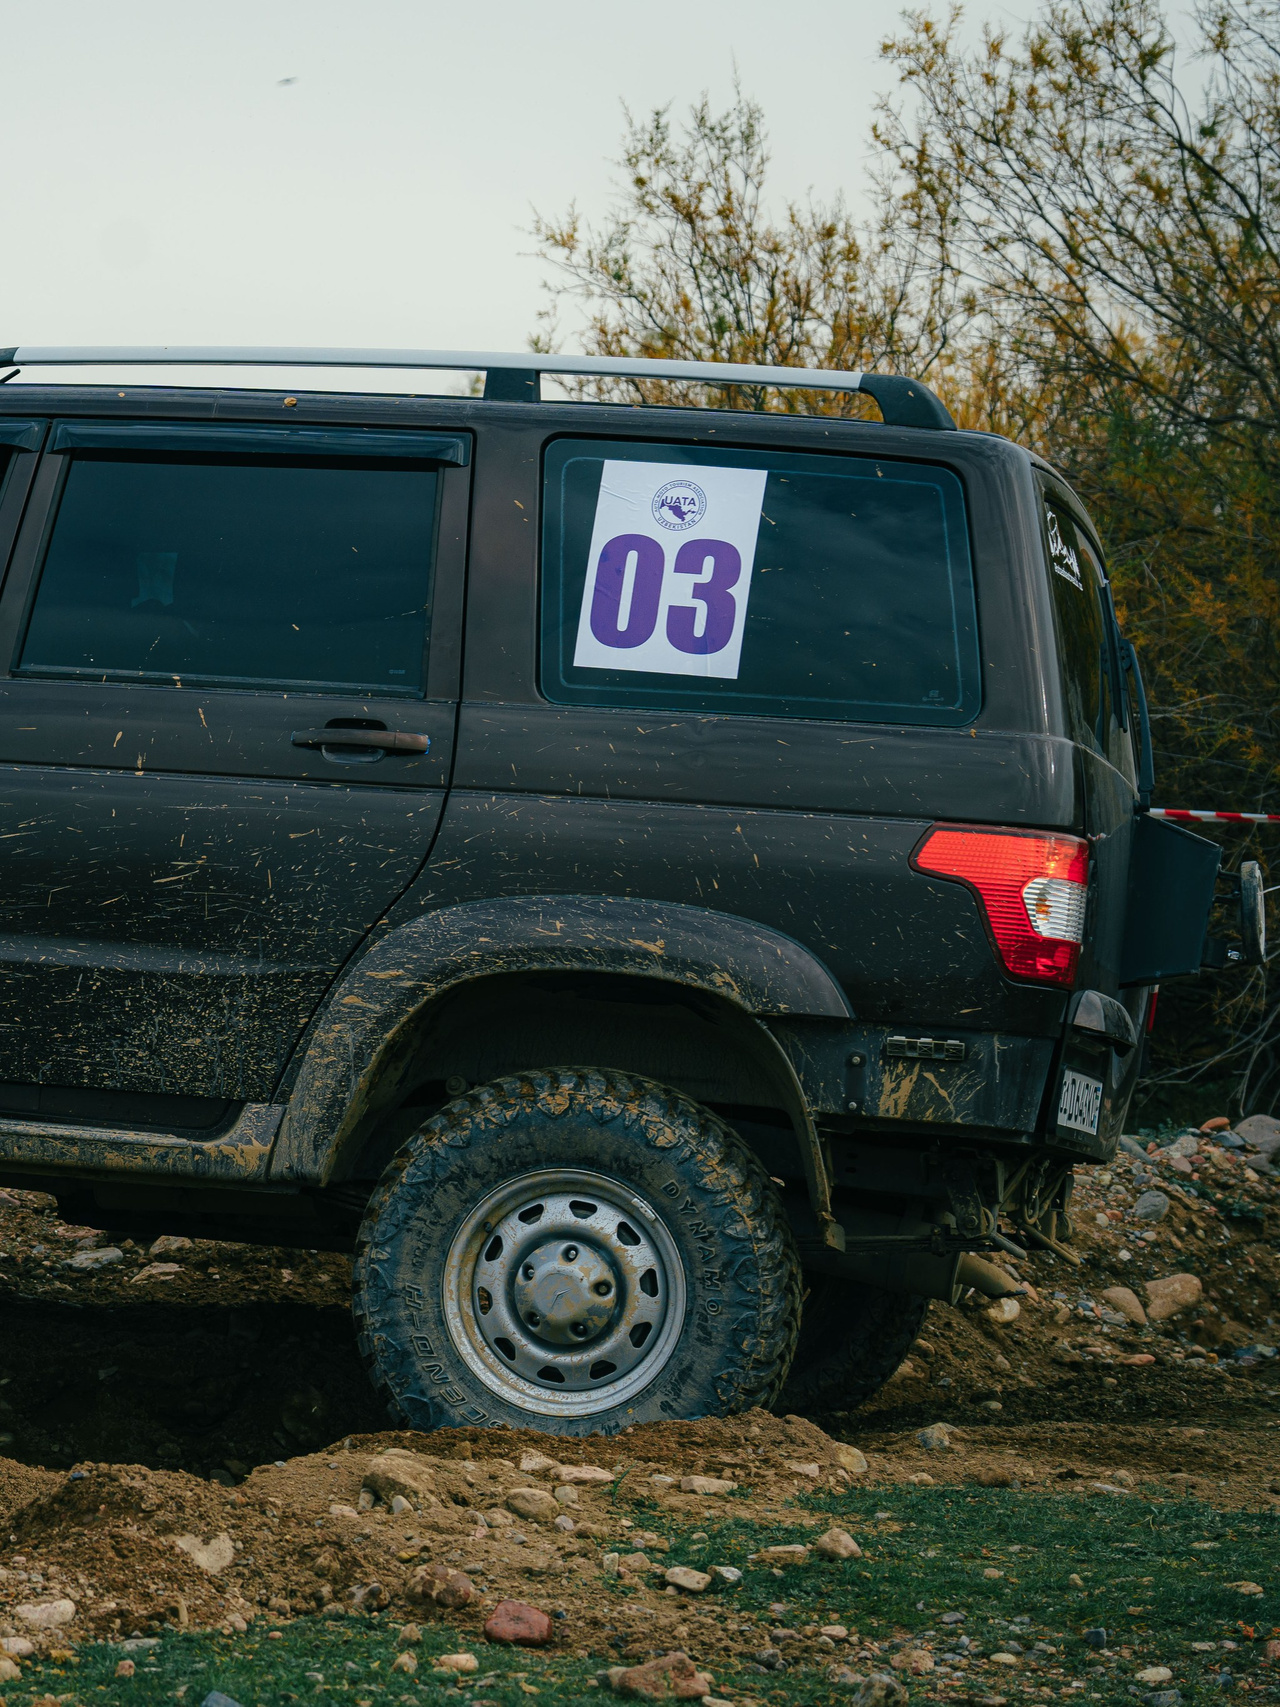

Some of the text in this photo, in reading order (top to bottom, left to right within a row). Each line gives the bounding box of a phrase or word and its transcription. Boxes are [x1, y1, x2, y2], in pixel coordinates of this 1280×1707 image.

[657, 517, 696, 529] UZBEKISTAN
[664, 495, 696, 506] UATA
[589, 533, 742, 655] 03
[660, 1179, 722, 1316] DYNAMO
